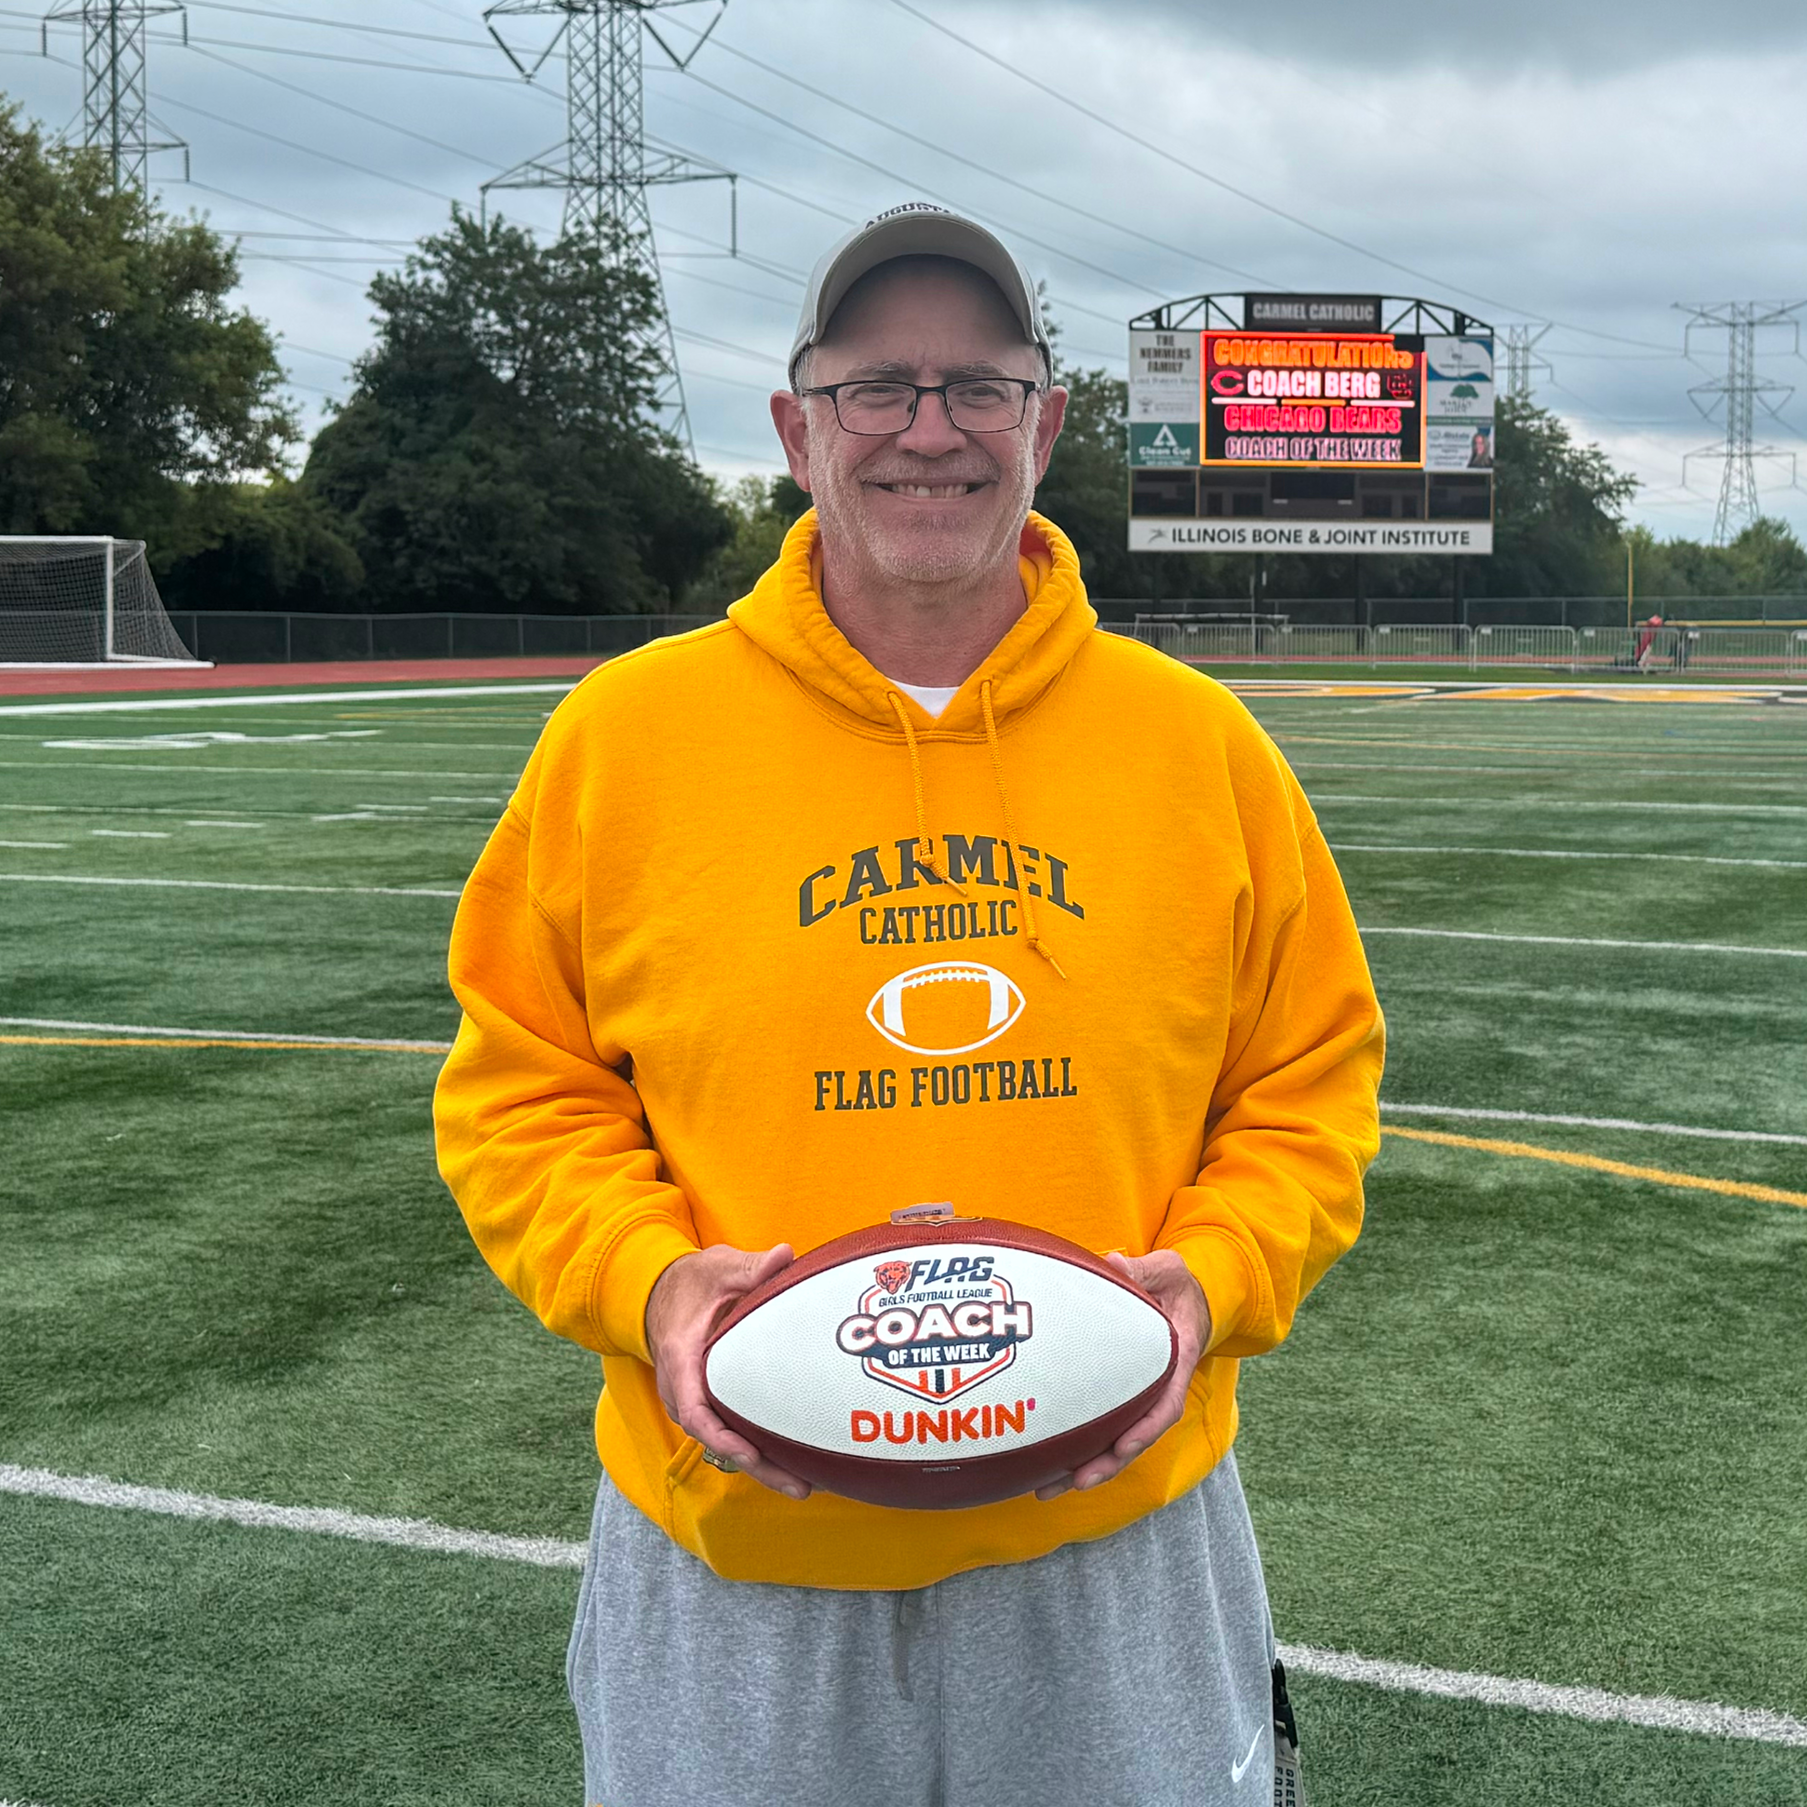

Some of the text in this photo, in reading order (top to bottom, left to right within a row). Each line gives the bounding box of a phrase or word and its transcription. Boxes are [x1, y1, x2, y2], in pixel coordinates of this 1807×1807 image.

[1252, 302, 1375, 321] CARMEL CATHOLIC
[1148, 361, 1183, 373] FAMILY
[1247, 370, 1381, 398] COACH BERG
[1224, 405, 1326, 432] CHICAGO
[1329, 406, 1402, 434] BEARS
[1225, 436, 1402, 461] COACH OF THE WEEK
[1172, 528, 1470, 545] ILLINOIS BONE & JOINT INSTITUTE
[799, 834, 1085, 927] CARMEL
[859, 900, 1018, 944] CATHOLIC
[814, 1057, 1077, 1111] FLAG FOOTBALL
[905, 1256, 995, 1293] FLAG
[879, 1288, 993, 1307] GIRLS FOOTBALL LEAGUE
[838, 1302, 1031, 1353] COACH
[888, 1343, 991, 1366] OF THE WEEK
[850, 1398, 1036, 1444] DUNKIN'
